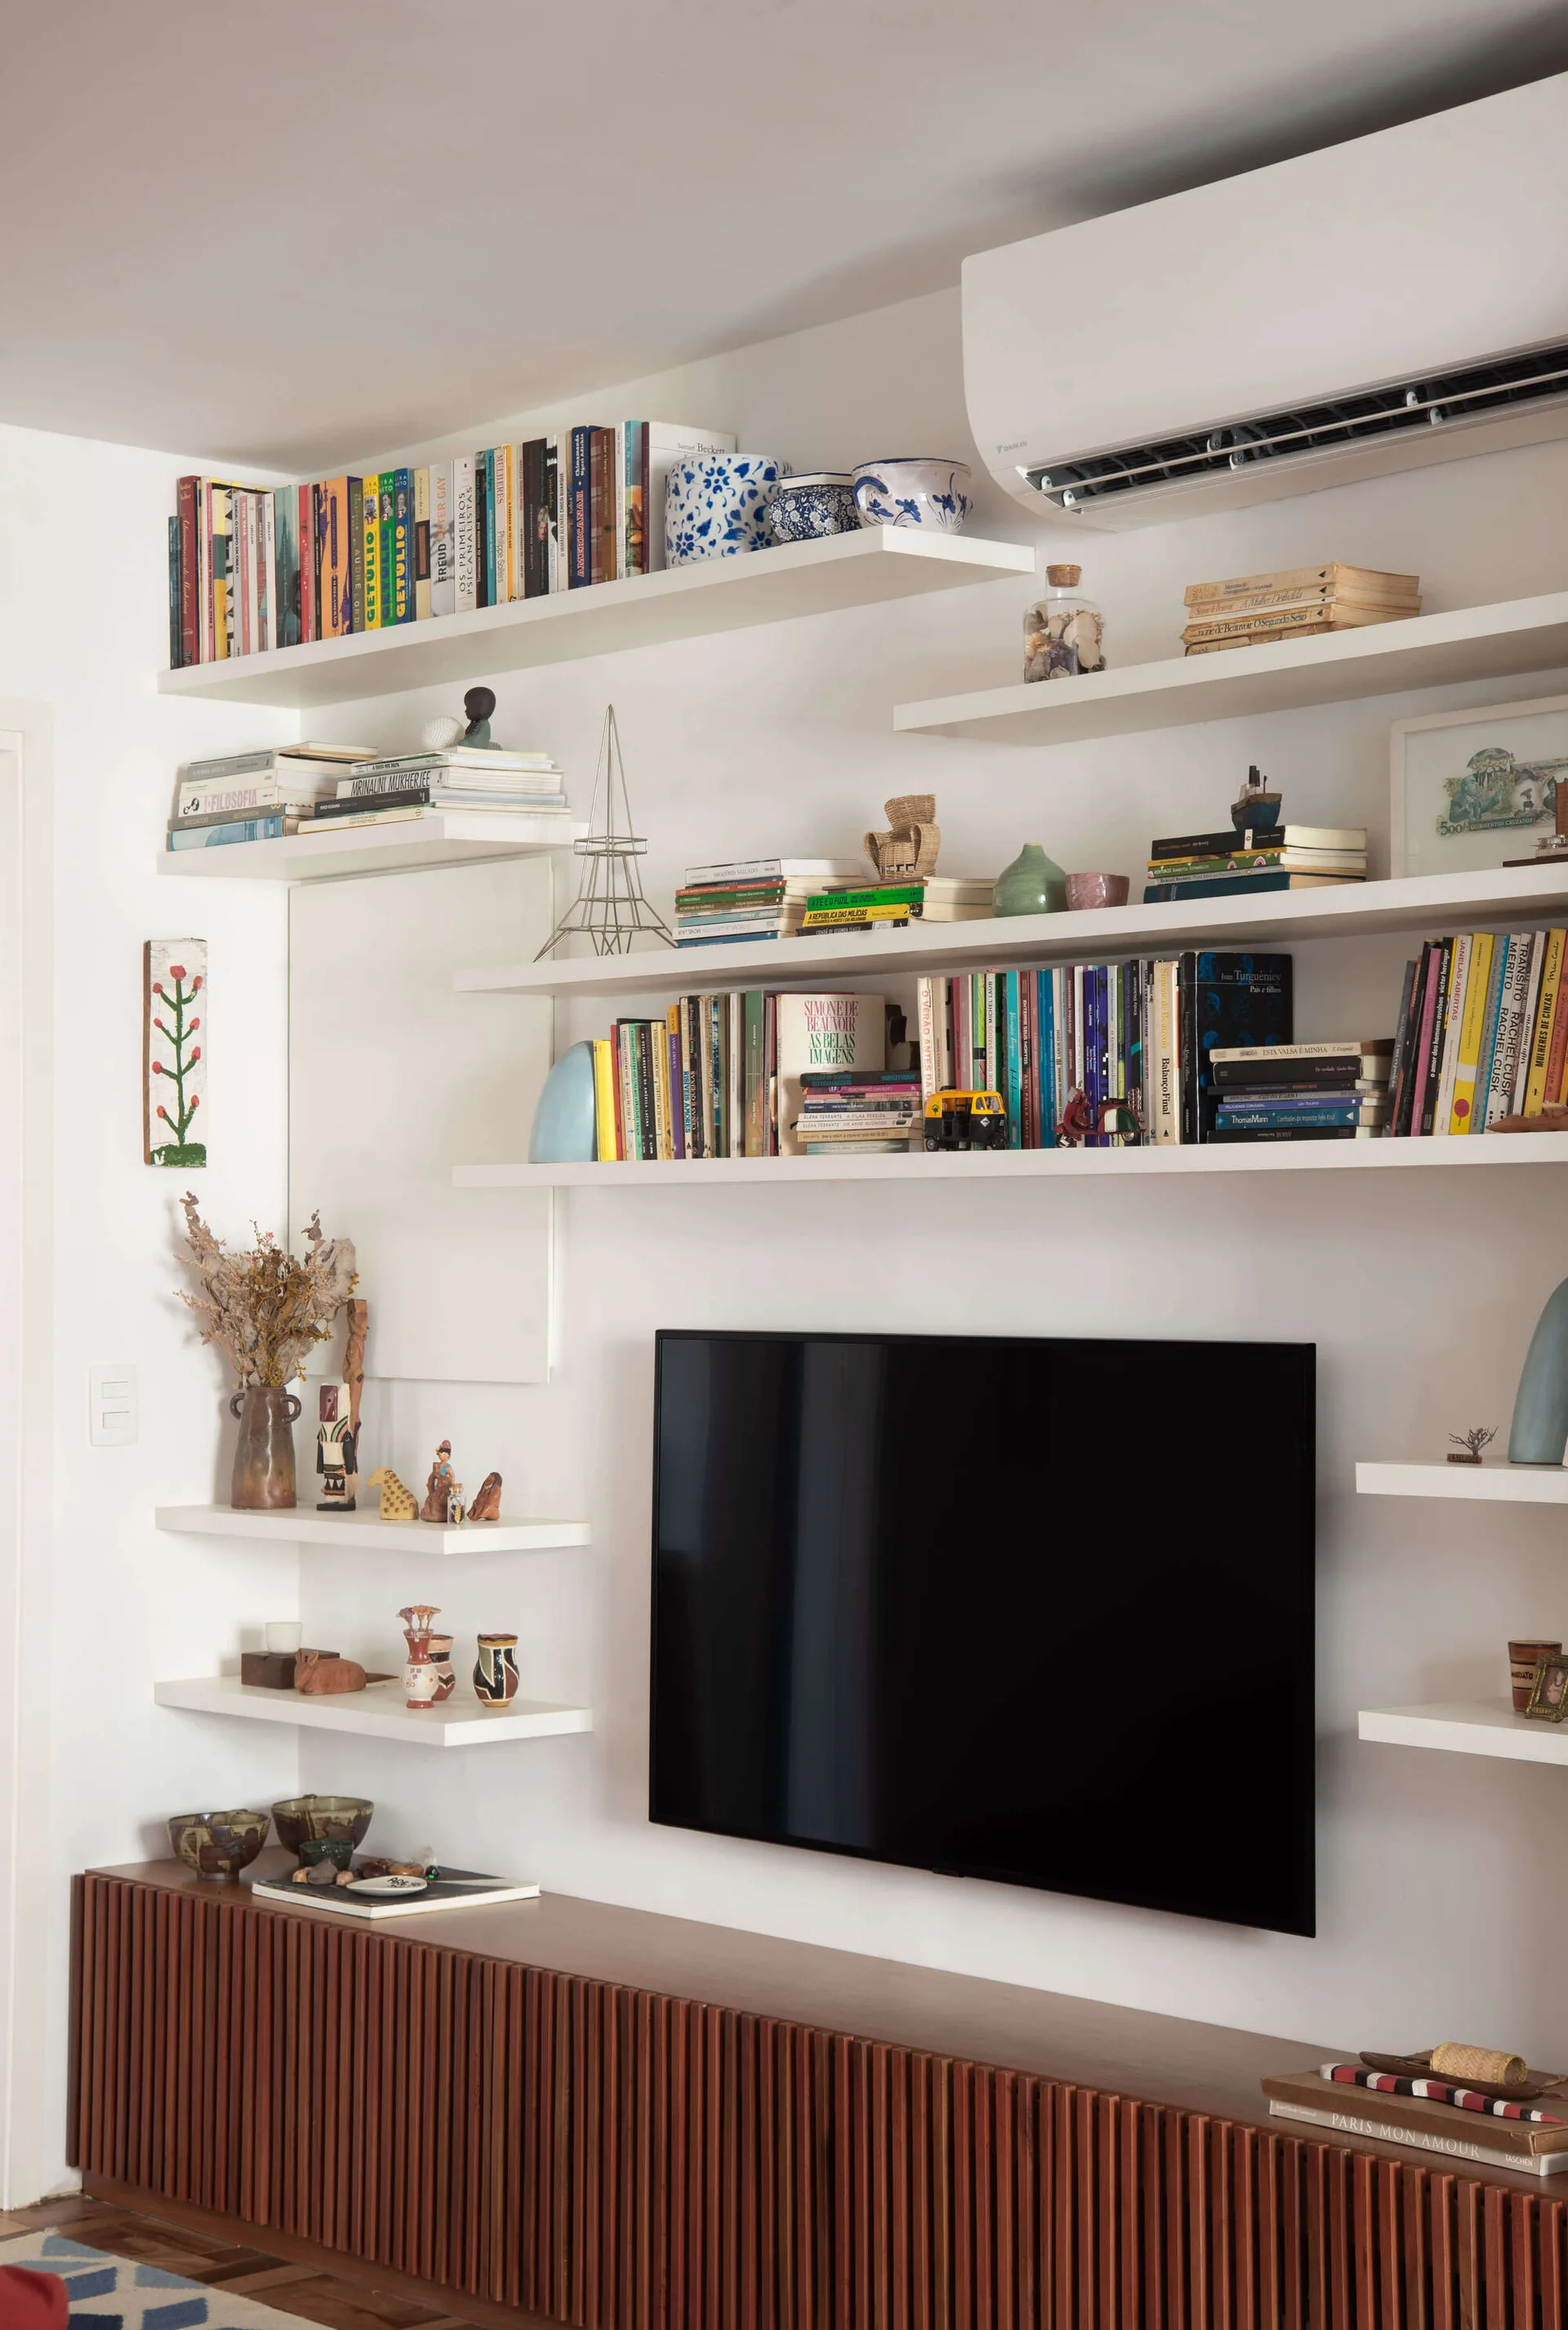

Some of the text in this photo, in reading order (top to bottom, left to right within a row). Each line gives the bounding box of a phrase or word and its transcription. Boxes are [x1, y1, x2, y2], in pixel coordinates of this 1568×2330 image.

[697, 443, 725, 455] Beckett
[496, 455, 504, 504] MULHERES
[436, 477, 448, 582] FREUD PETER GAY
[458, 493, 466, 592] OS PRIMEIROS
[576, 490, 585, 578] AMERICANAH
[497, 531, 505, 559] Philippe
[1224, 623, 1253, 633] Beauvoir
[1261, 615, 1290, 627] Segundo
[350, 770, 431, 797] MRINALINI MUKHERJEE
[212, 789, 257, 810] FILOSOFIA
[813, 911, 837, 920] REPÚBLICA
[849, 908, 868, 916] MILÍCIAS
[1441, 948, 1450, 974] heringer
[1547, 960, 1559, 982] Mia
[1250, 985, 1261, 993] Pais
[1267, 984, 1282, 993] filhos
[1451, 938, 1467, 1021] JANELAS ABERTAS
[804, 1000, 859, 1016] SIMONE DE
[924, 1000, 932, 1036] VERÃO
[1160, 969, 1170, 1049] Simone de Beauvoir
[1436, 996, 1445, 1020] avulsos
[1543, 992, 1554, 1018] CINZAS
[807, 1016, 856, 1032] BEAUVOIR
[1433, 1020, 1442, 1045] homens
[1494, 1007, 1509, 1057] RACHEL
[1504, 1012, 1520, 1061] RACHEL
[1522, 1014, 1531, 1045] noturno
[1540, 1021, 1550, 1029] DE
[809, 1033, 855, 1048] AS BELAS
[1262, 1049, 1279, 1057] ESTA
[1304, 1045, 1328, 1054] MINHA
[1431, 1045, 1439, 1056] dos
[1535, 1031, 1548, 1067] MULHERES
[809, 1049, 855, 1064] IMAGENS
[924, 1039, 933, 1072] ANTES
[925, 1074, 933, 1089] DA
[1160, 1058, 1170, 1116] Balanço Final
[1489, 1058, 1503, 1093] CUSK
[1499, 1063, 1513, 1098] CUSK
[1232, 1115, 1251, 1124] Thomas
[1250, 1114, 1269, 1123] Mann
[1331, 2113, 1480, 2158] PARIS MON AMOUR
[1504, 2153, 1533, 2167] TASCHEN
